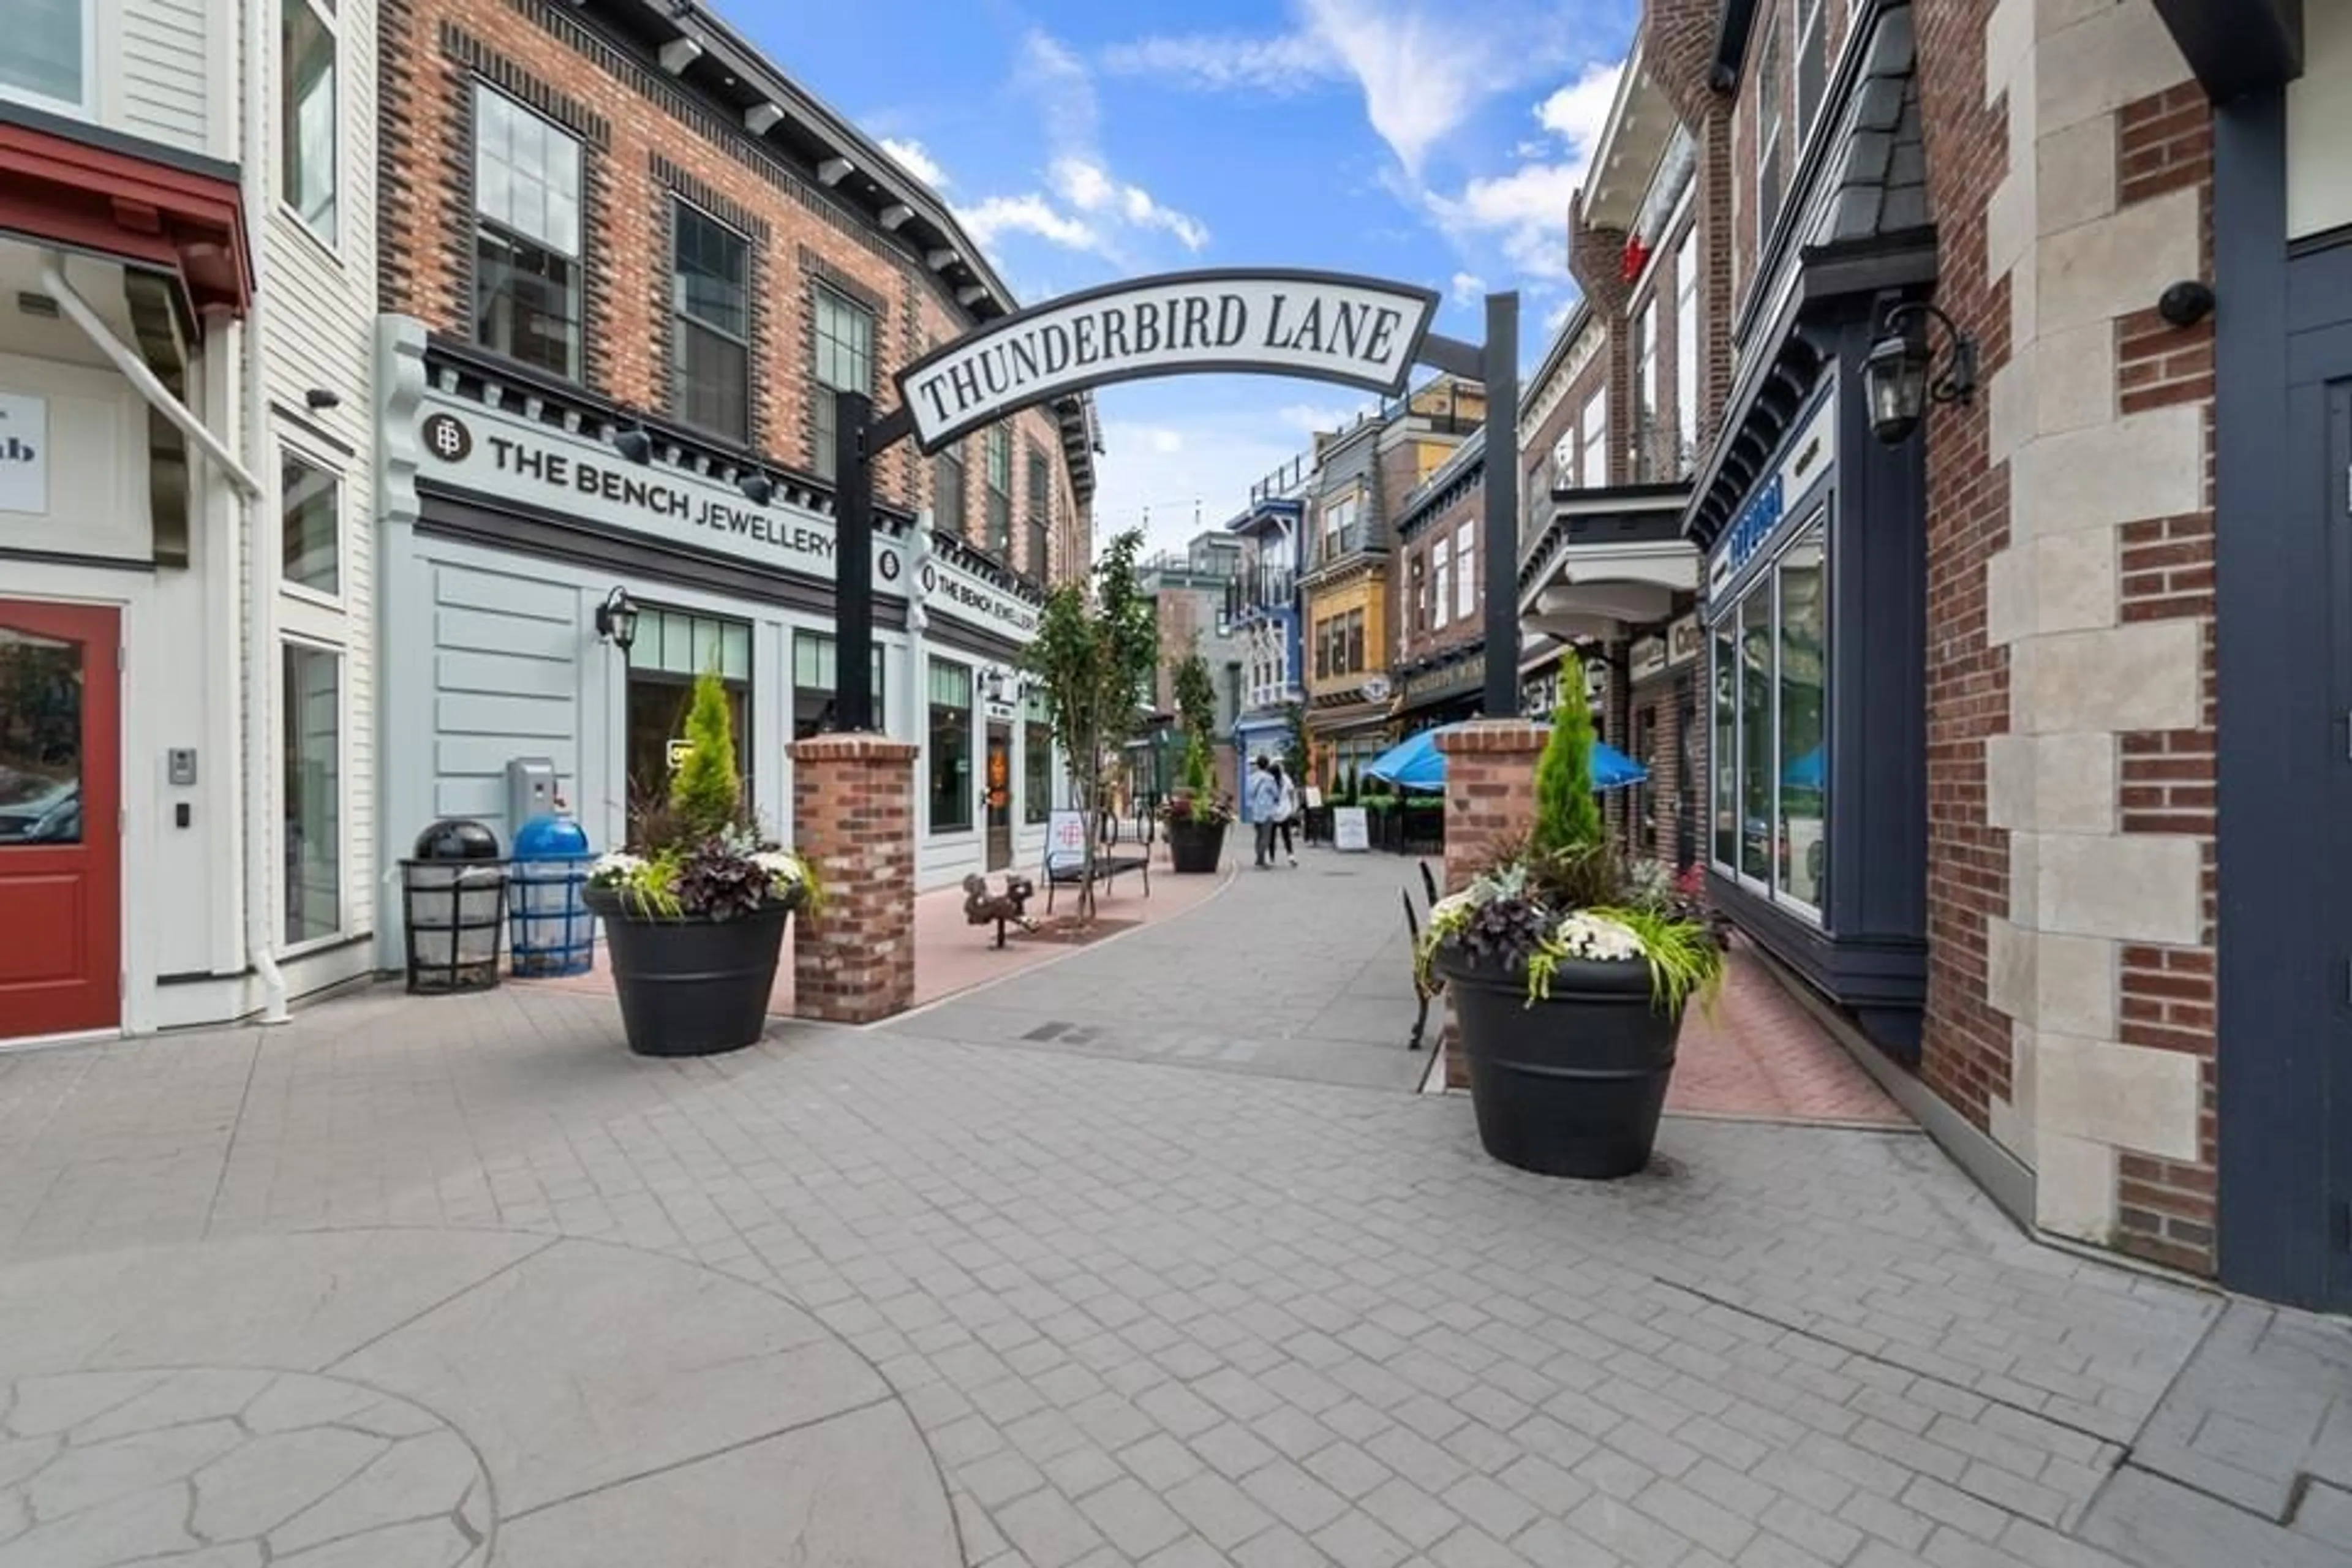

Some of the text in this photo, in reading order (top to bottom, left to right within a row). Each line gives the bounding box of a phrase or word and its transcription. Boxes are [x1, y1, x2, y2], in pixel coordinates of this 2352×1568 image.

[919, 294, 1401, 423] THUNDERBIRD LANE
[488, 435, 836, 559] THE BENCH JEWELLERY
